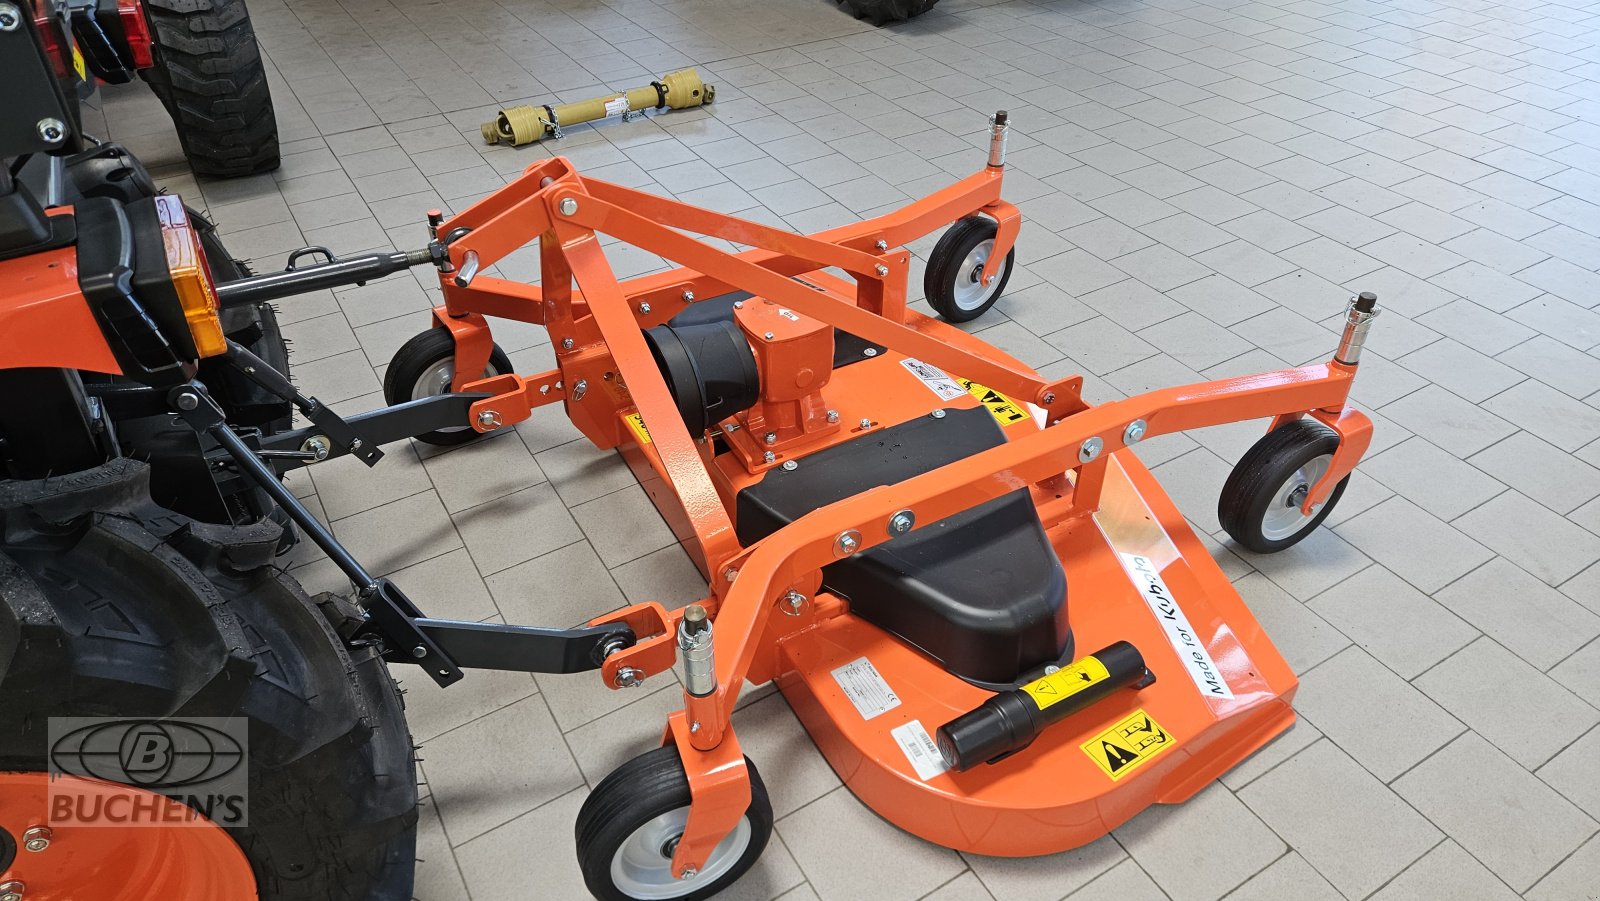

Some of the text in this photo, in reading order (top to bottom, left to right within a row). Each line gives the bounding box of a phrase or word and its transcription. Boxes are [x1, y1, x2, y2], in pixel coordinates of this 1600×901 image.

[1133, 556, 1225, 695] Made for Kubota
